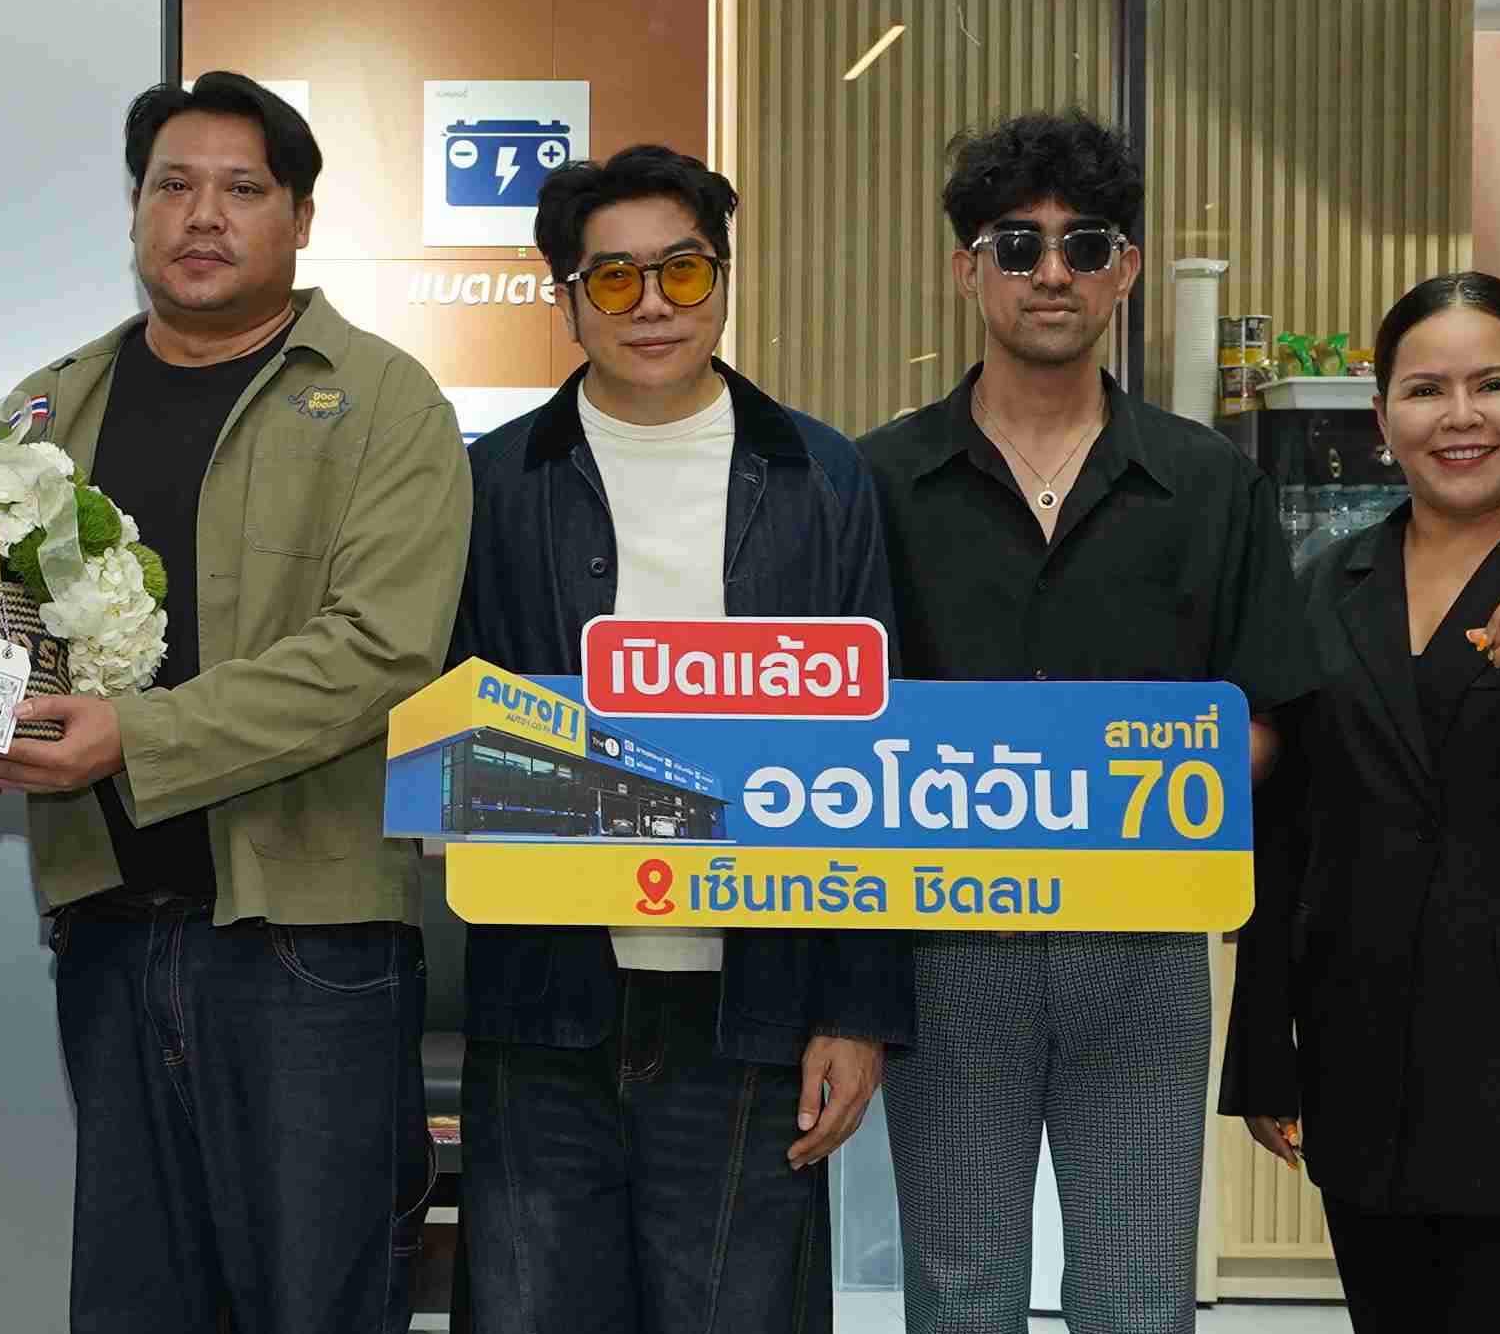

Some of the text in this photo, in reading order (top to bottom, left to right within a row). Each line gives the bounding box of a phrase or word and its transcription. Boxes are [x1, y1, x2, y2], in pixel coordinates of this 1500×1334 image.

[611, 634, 861, 699] เปิดแล้ว!
[1105, 704, 1220, 749] สาขาที่
[743, 739, 1090, 831] ออโต้วัน
[1108, 758, 1225, 841] 70
[690, 857, 1062, 916] เซ็นทรัล ชิดลม
